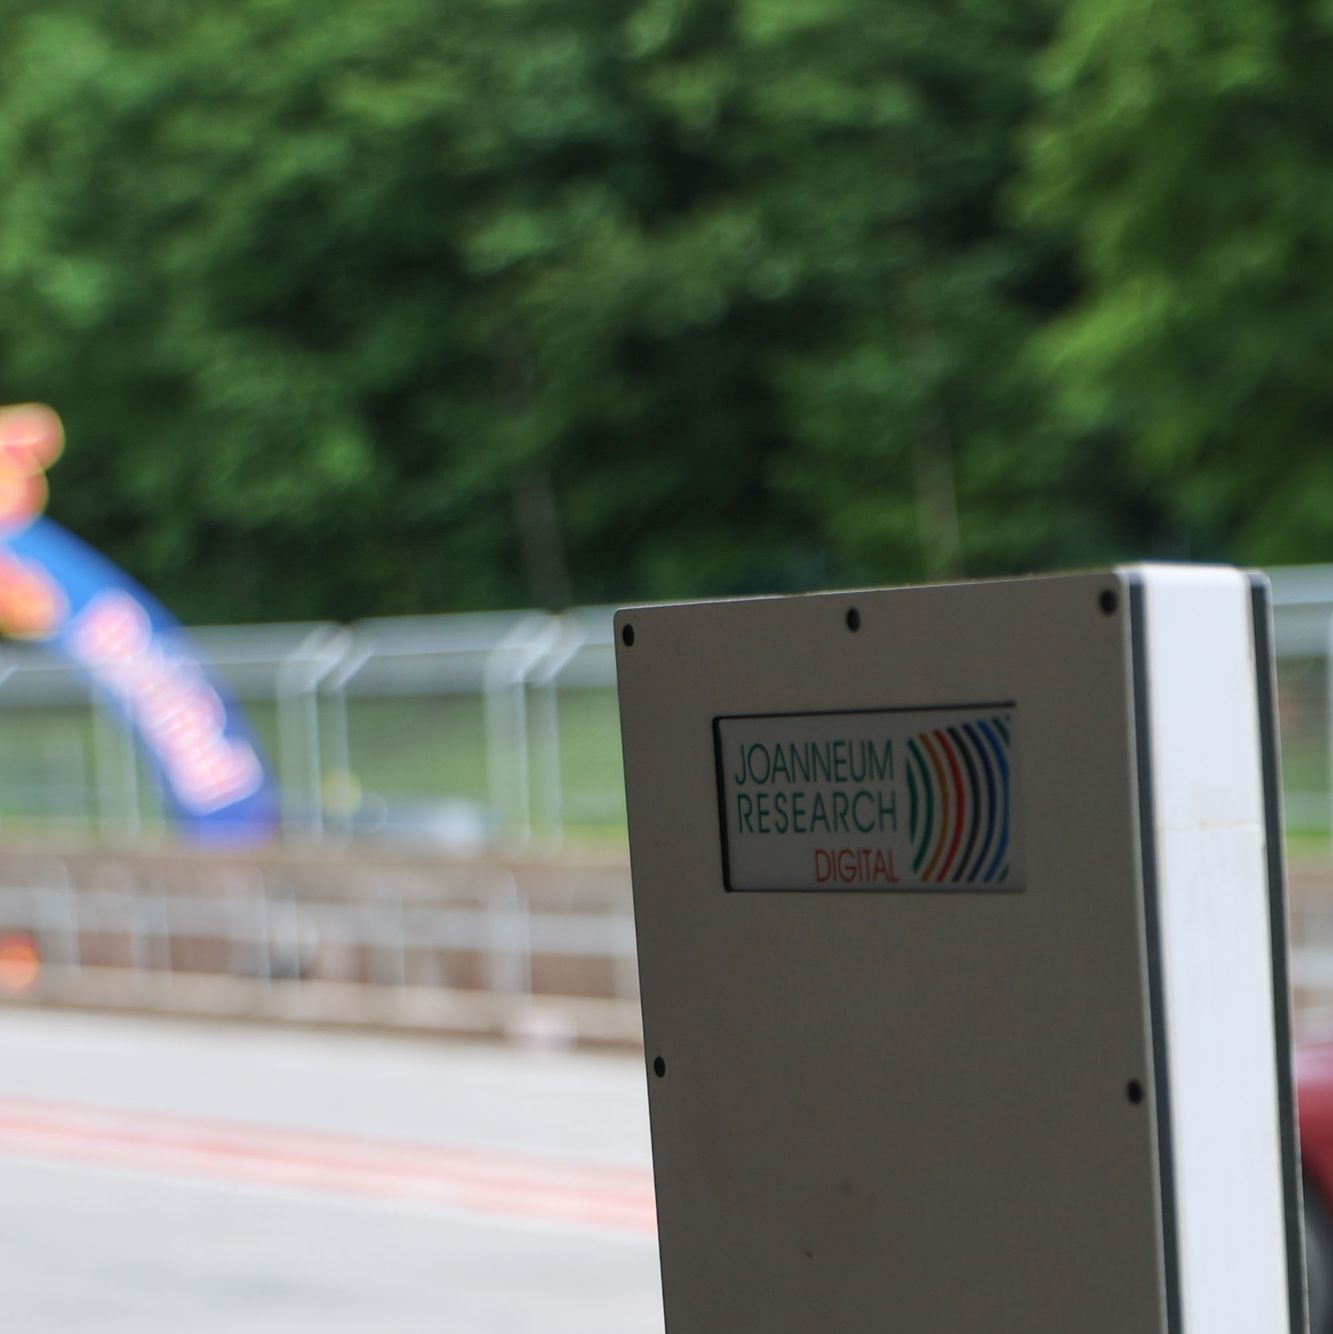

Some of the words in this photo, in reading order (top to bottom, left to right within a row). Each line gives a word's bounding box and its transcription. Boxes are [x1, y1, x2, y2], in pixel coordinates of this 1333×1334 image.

[735, 739, 894, 785] JOANNEUM
[738, 790, 898, 834] RESEARCH
[814, 848, 900, 883] DIGITAL
